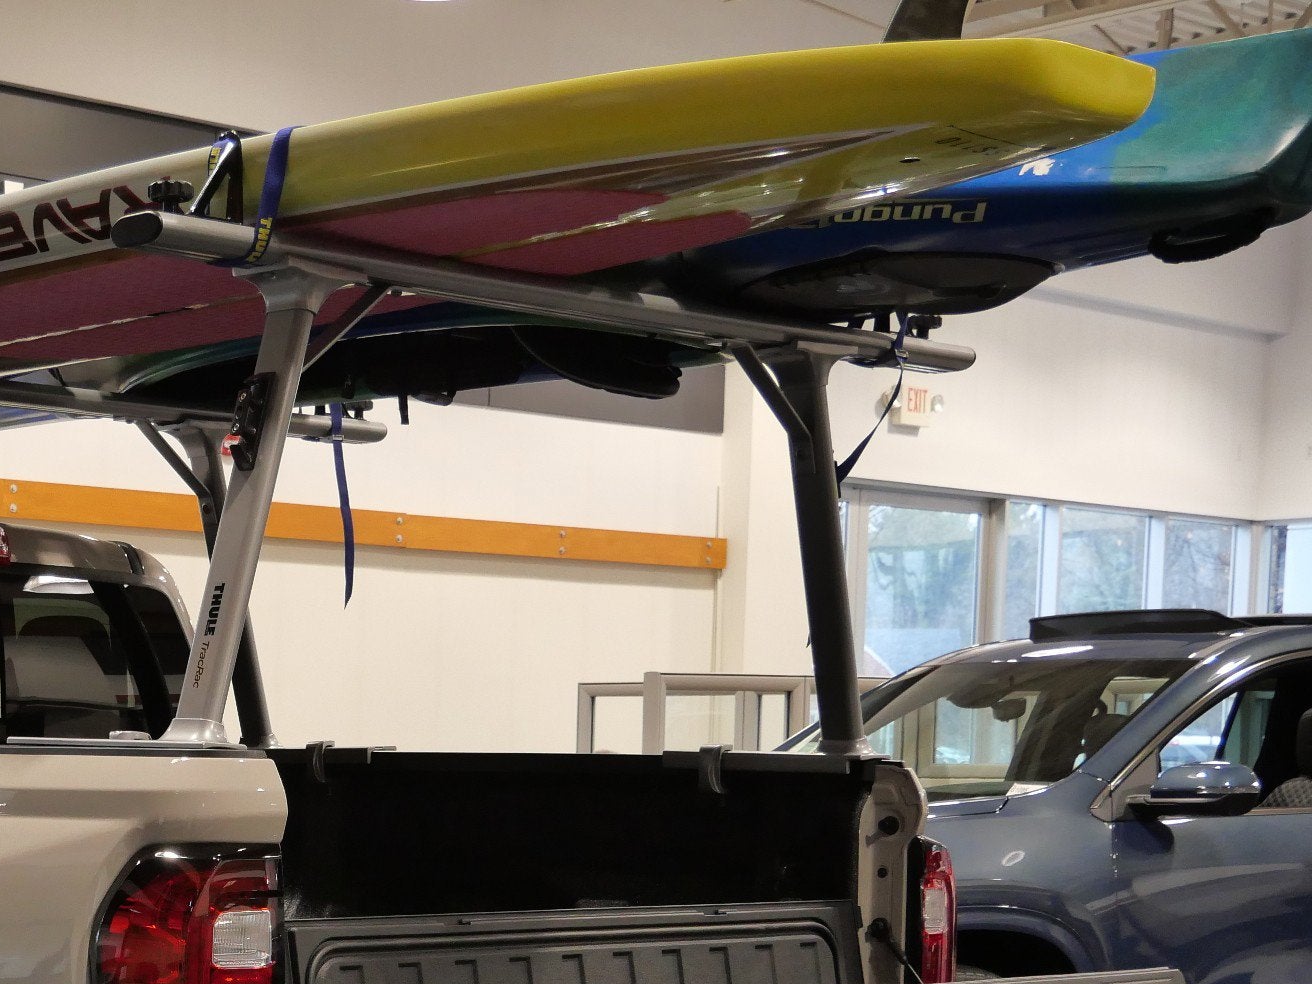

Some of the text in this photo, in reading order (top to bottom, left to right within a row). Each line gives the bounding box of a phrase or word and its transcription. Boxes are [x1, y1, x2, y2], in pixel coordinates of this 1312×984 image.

[907, 387, 928, 413] EXIT
[193, 583, 225, 689] THULE TracRac
